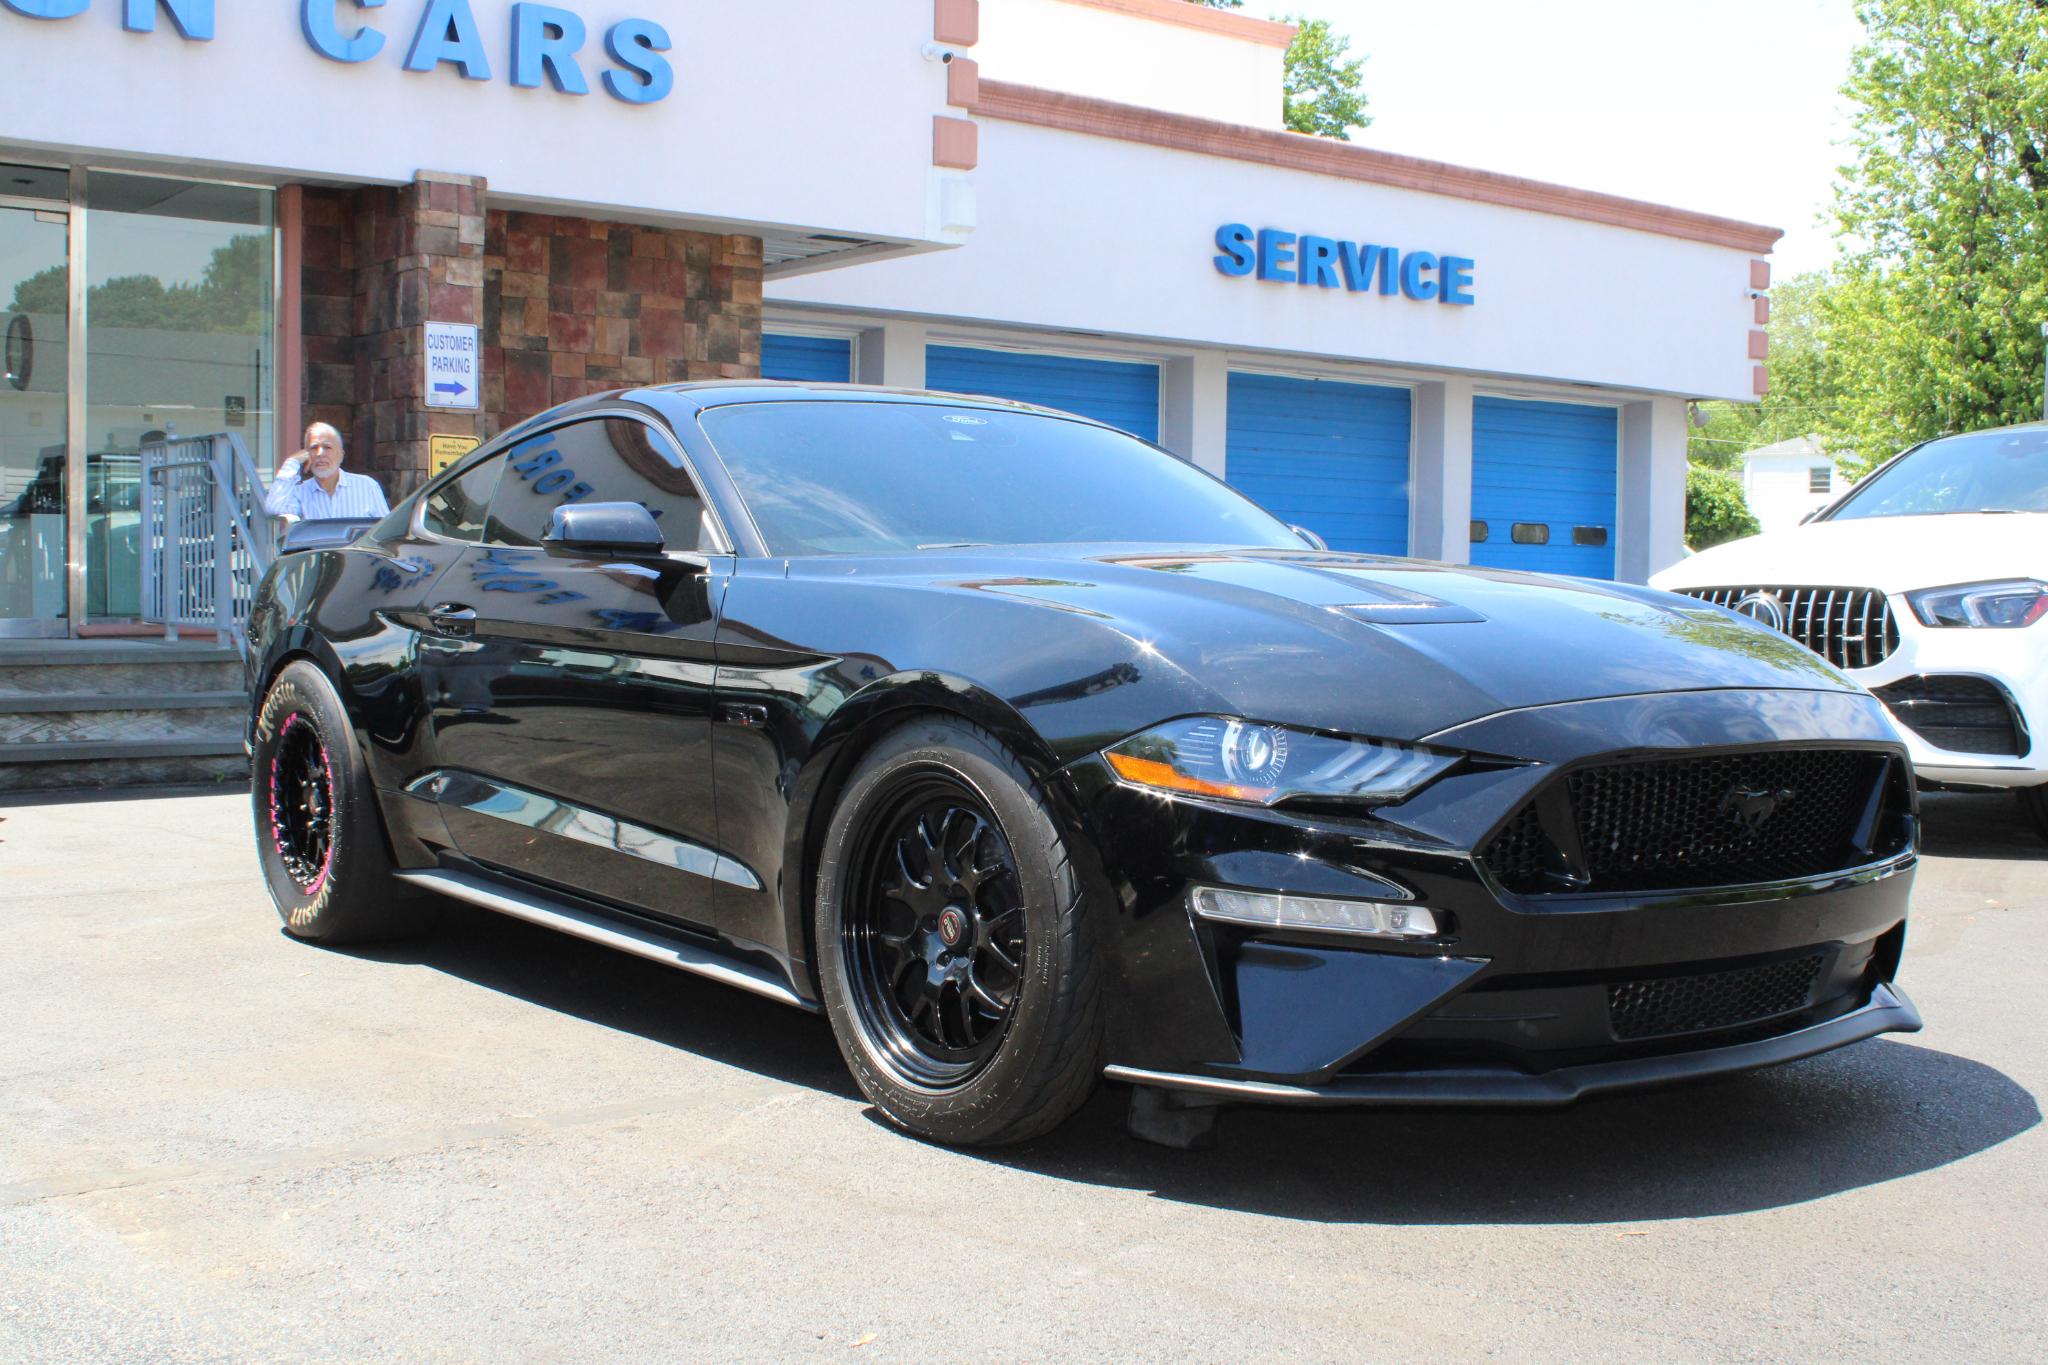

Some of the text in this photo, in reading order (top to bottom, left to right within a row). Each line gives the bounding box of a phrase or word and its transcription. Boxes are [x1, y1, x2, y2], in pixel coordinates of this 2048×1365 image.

[301, 0, 673, 104] CARS
[1213, 223, 1475, 305] SERVICE
[428, 334, 474, 352] CUSTOMER
[432, 356, 471, 373] PARKING
